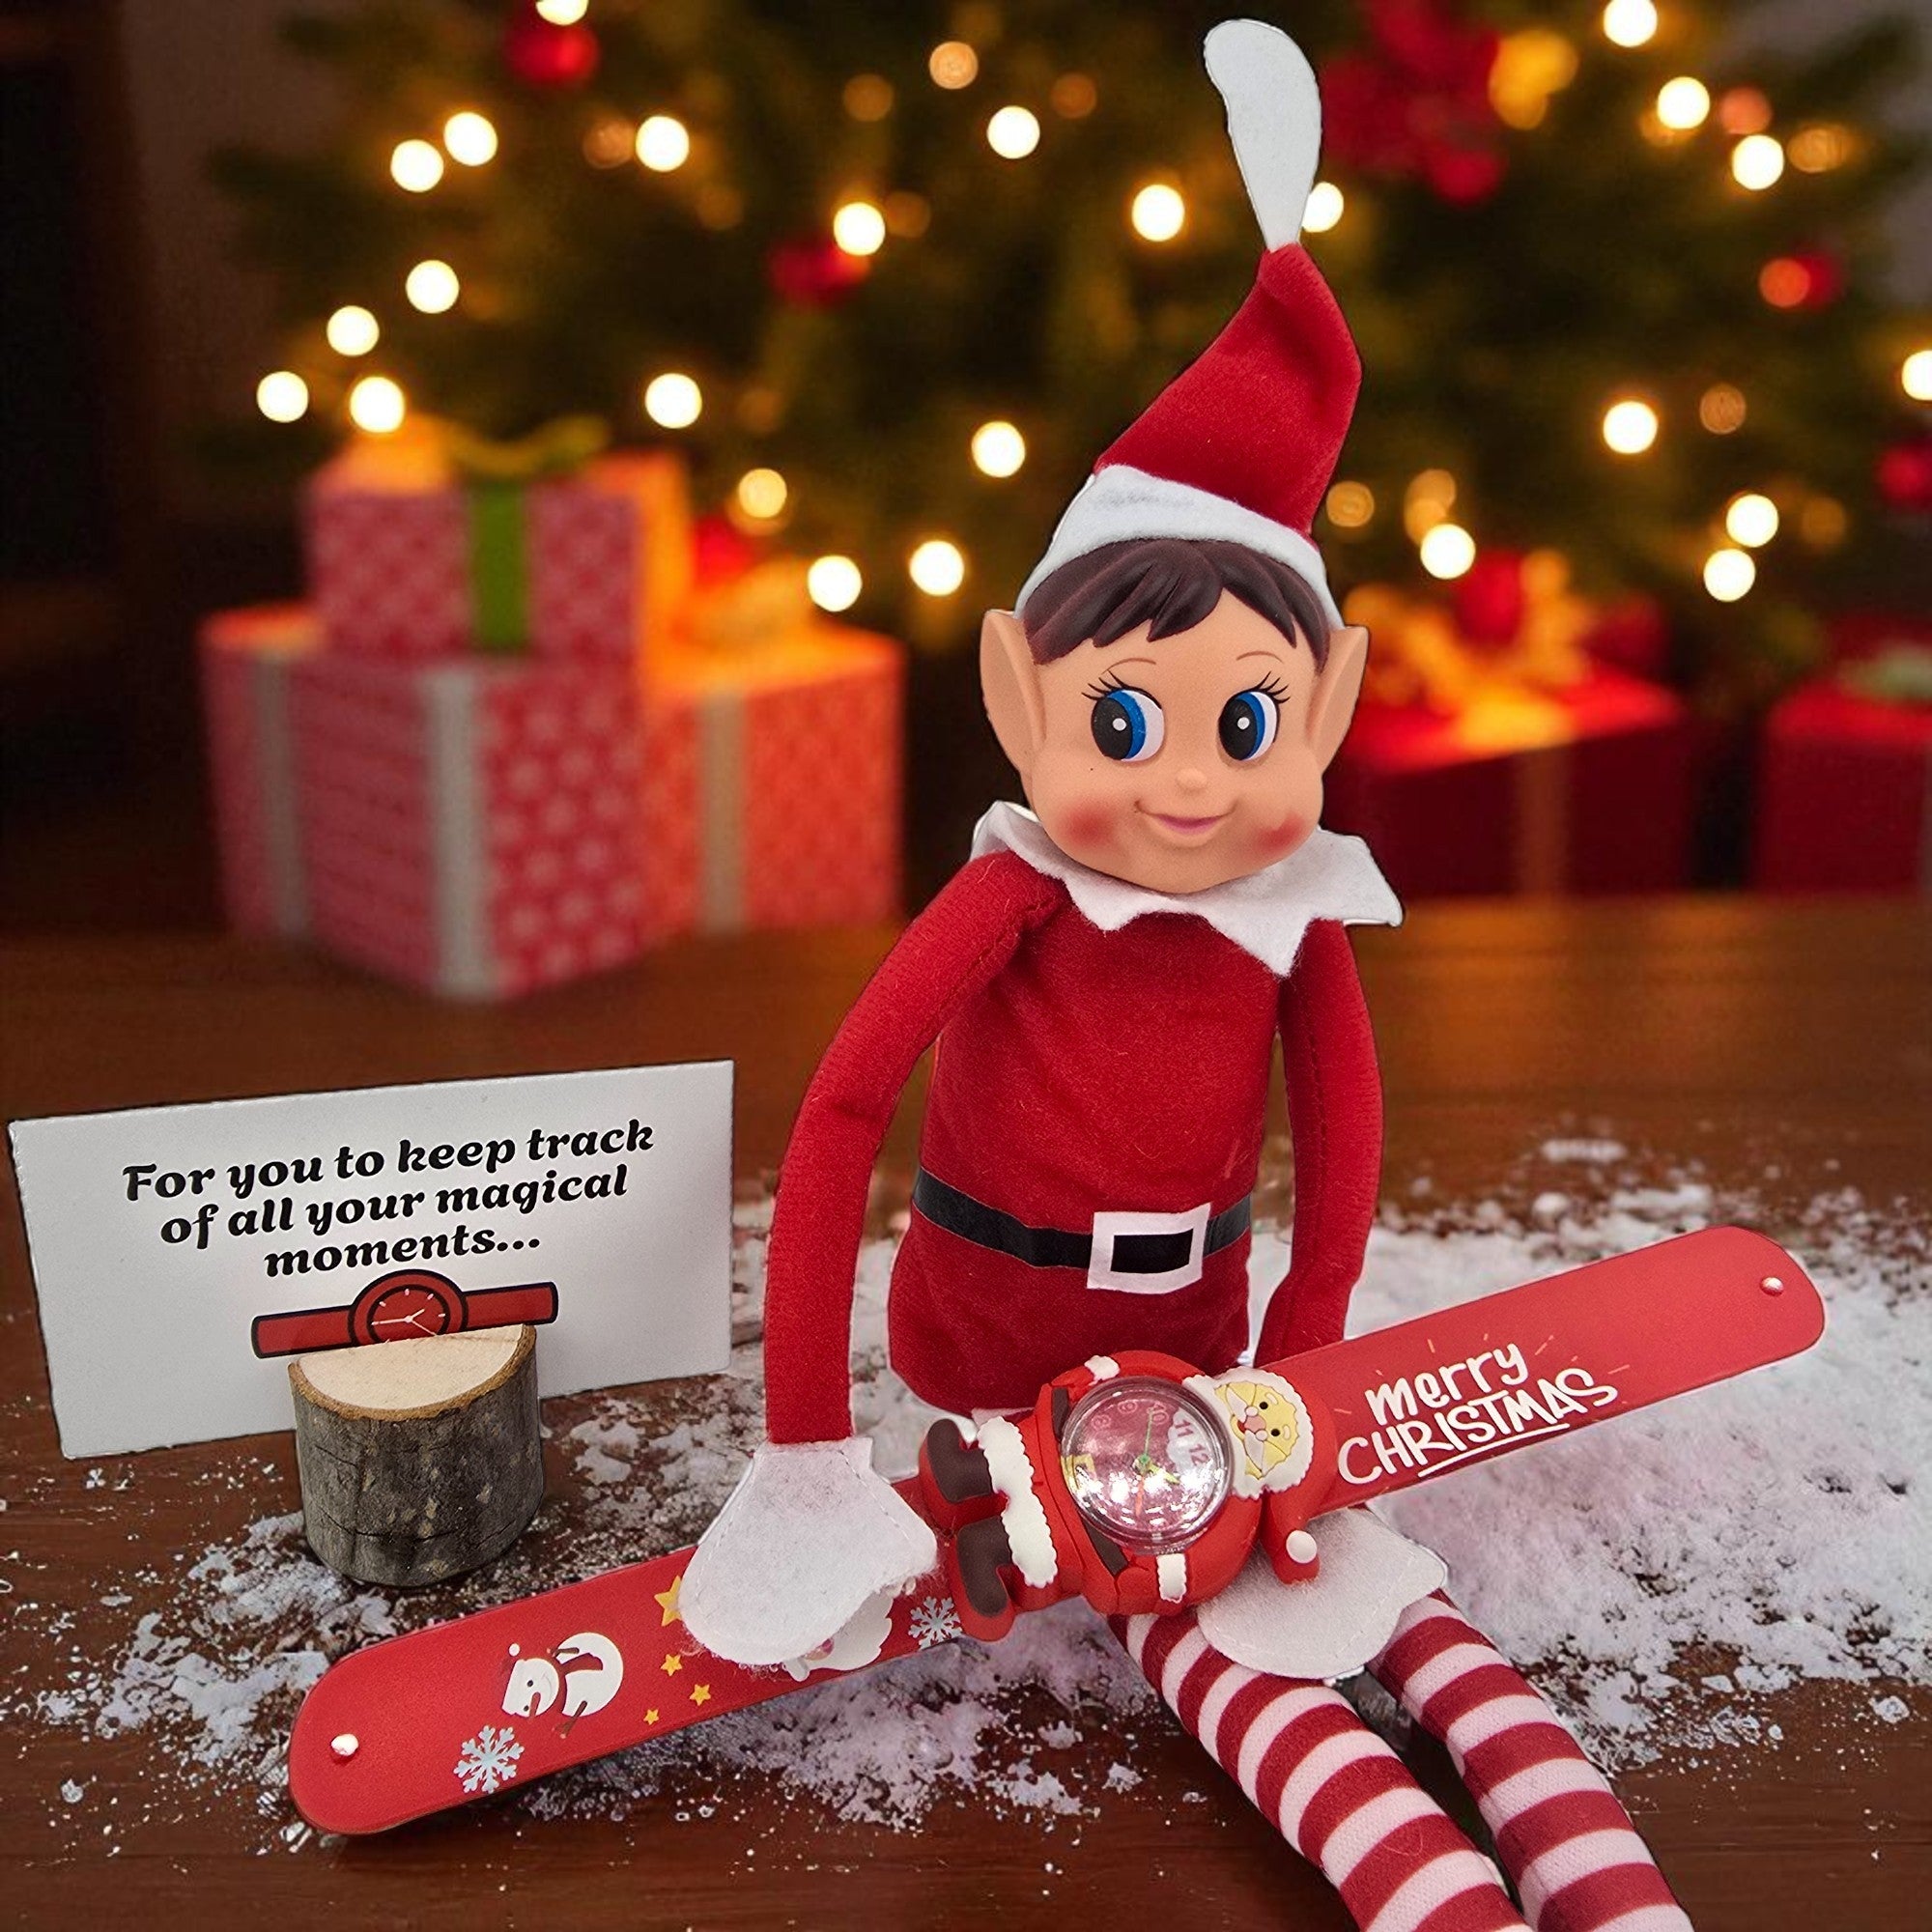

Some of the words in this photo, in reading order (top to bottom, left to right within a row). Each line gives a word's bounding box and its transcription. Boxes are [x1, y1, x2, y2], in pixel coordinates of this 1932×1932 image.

[123, 1164, 214, 1201] For
[227, 1158, 323, 1199] you
[335, 1147, 384, 1179] to
[399, 1140, 515, 1173] keep
[527, 1120, 653, 1160] track
[161, 1205, 218, 1249] of
[229, 1198, 293, 1236] all
[306, 1193, 424, 1236] your
[436, 1164, 627, 1213] magical
[265, 1230, 539, 1277] moments...
[1175, 1419, 1194, 1437] 11
[1189, 1443, 1209, 1466] 12
[1339, 1369, 1618, 1483] CHRISTMAS
